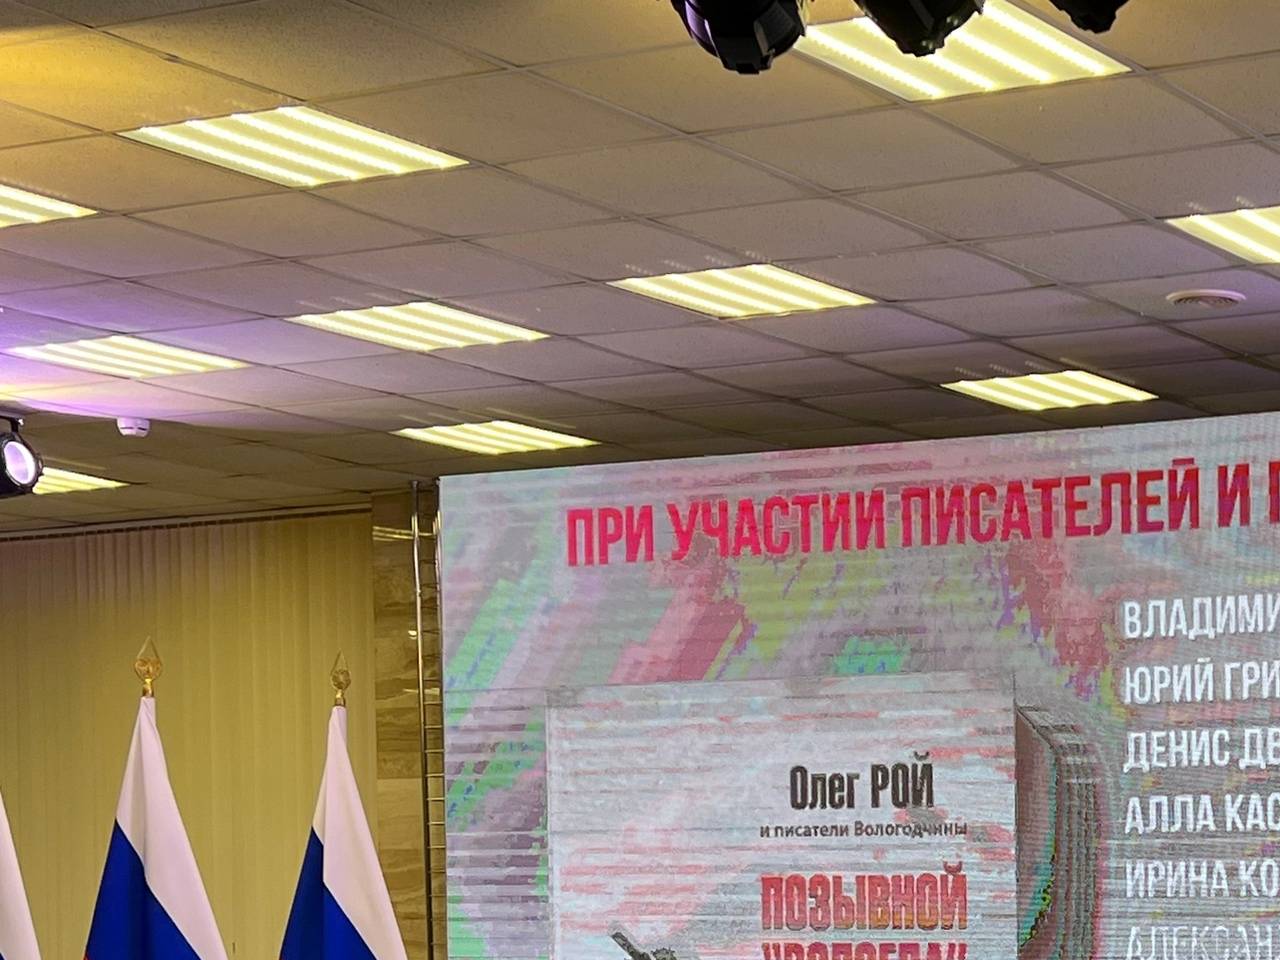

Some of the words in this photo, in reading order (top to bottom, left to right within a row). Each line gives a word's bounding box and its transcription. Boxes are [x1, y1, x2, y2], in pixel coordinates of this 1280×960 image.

[566, 505, 654, 566] ПРИ
[668, 490, 886, 561] УЧАСТИИ
[902, 458, 1199, 547] ПИСАТЕЛЕЙ
[1218, 463, 1250, 527] И
[1123, 658, 1214, 705] ЮРИЙ
[1123, 728, 1230, 773] ДЕНИС
[789, 765, 860, 810] Олег
[871, 751, 934, 808] РОЙ
[760, 825, 770, 838] и
[774, 824, 848, 837] писатели
[854, 821, 968, 839] Вологодчины
[1124, 794, 1216, 835] АЛЛА
[760, 861, 968, 931] ПОЗЫВНОЙ
[1125, 859, 1228, 898] ИРИНА
